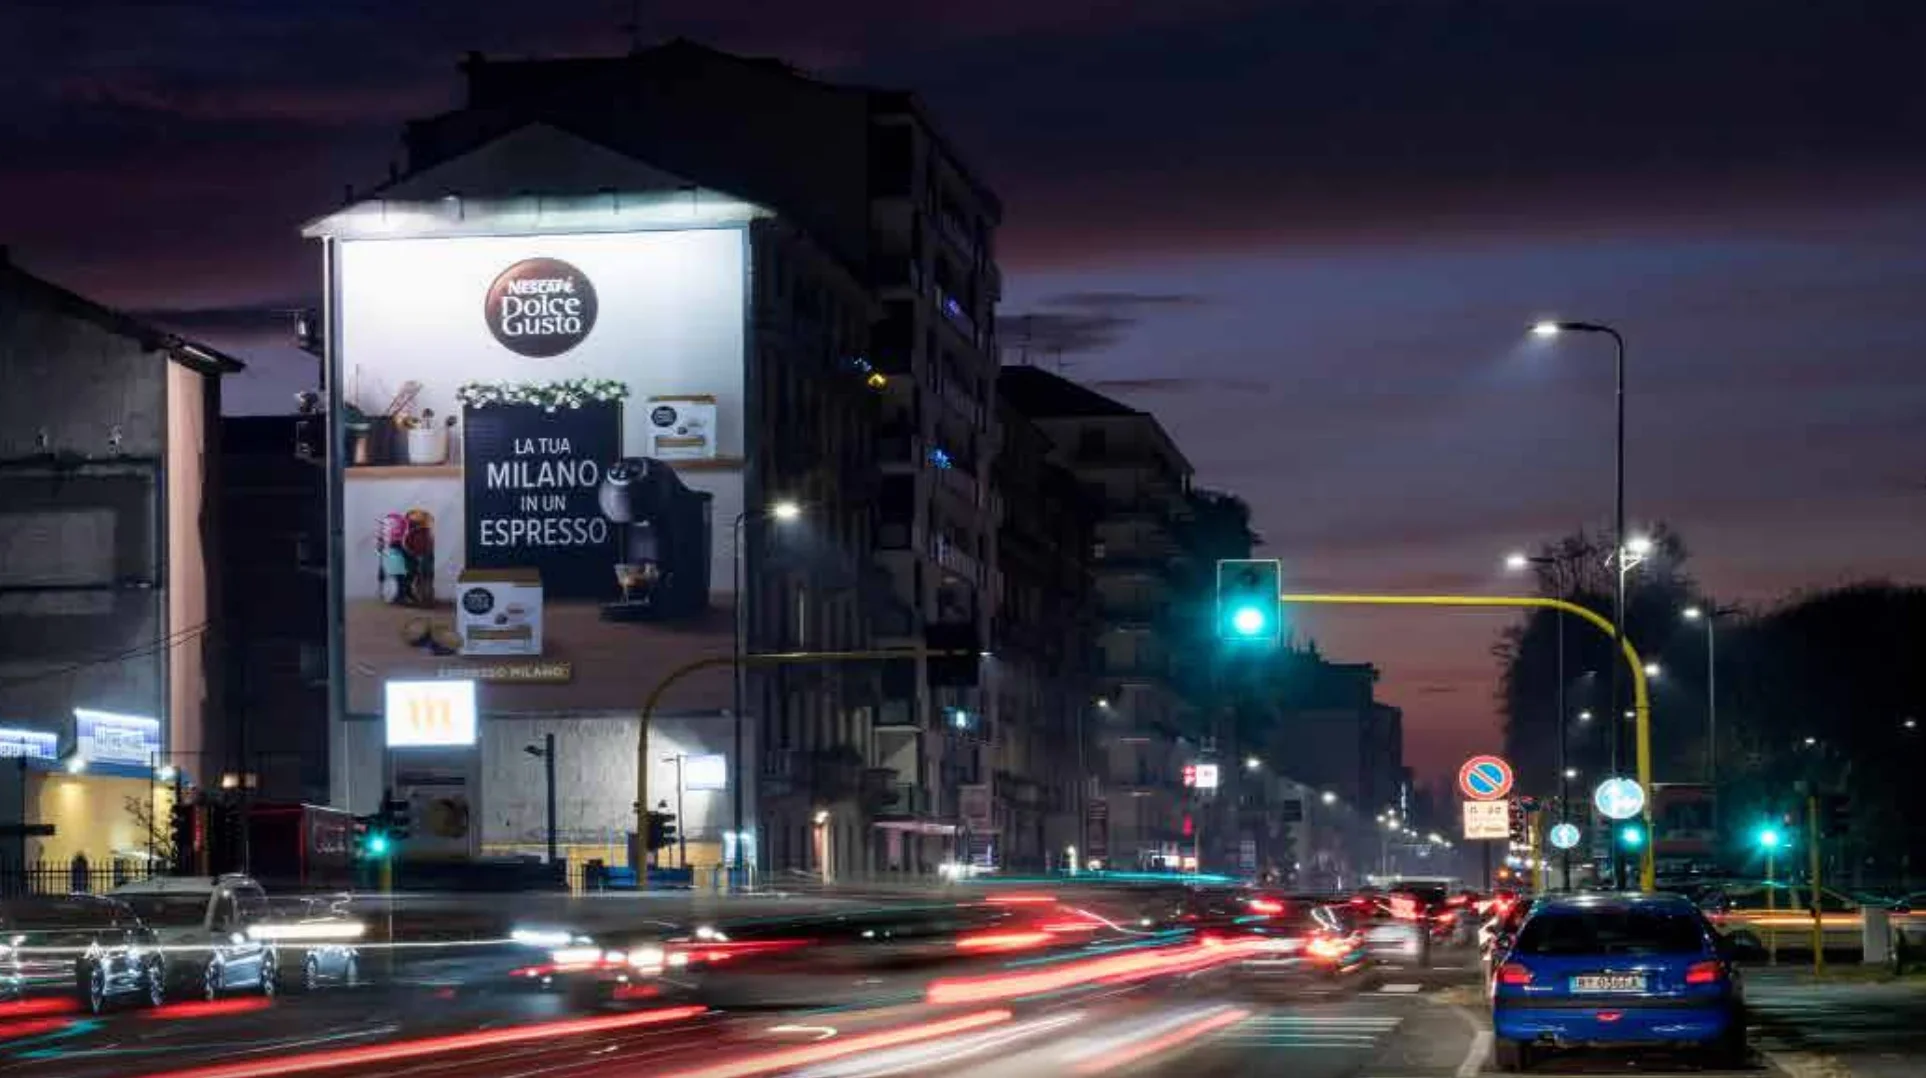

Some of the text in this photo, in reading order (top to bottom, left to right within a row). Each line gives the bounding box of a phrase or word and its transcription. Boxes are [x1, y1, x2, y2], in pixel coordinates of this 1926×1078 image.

[502, 295, 581, 317] Dolce
[502, 314, 581, 336] Gusto
[514, 438, 571, 454] LA TUA
[487, 460, 598, 488] MILANO
[520, 495, 566, 511] IN UN
[480, 518, 606, 546] ESPRESSO
